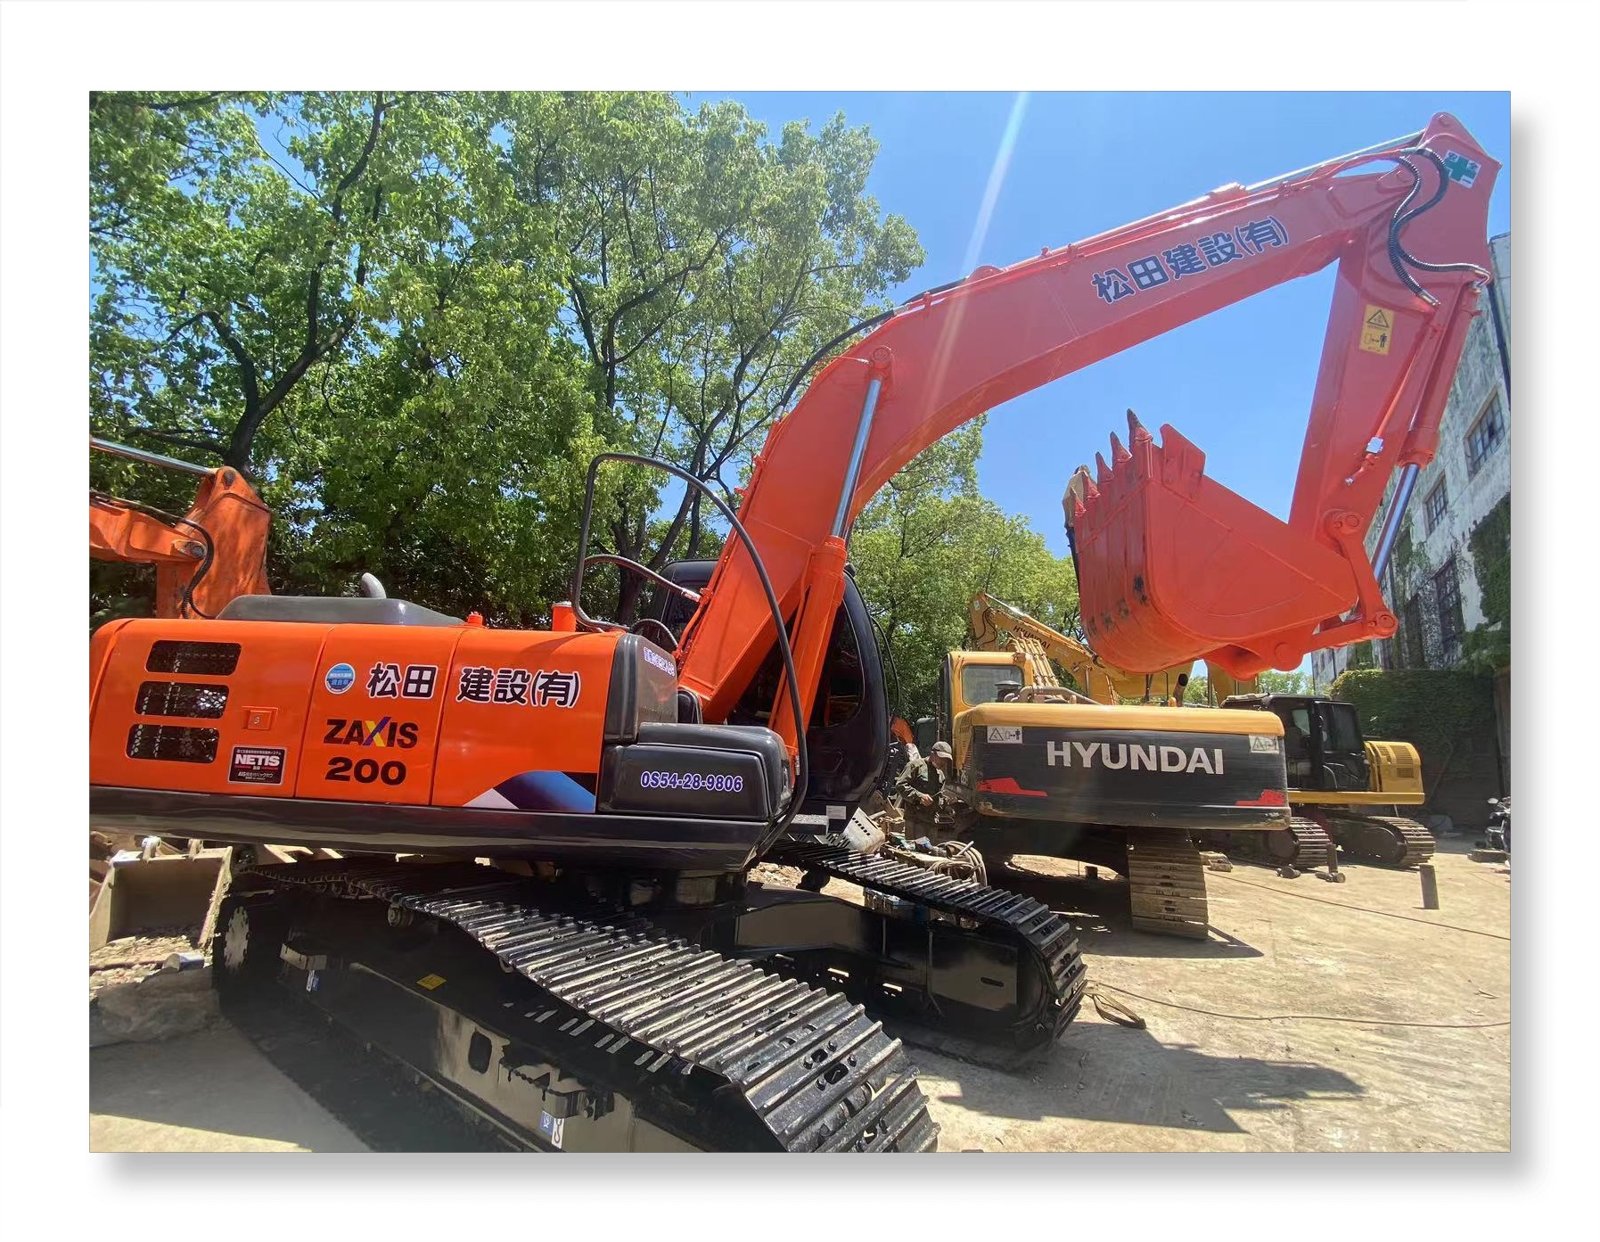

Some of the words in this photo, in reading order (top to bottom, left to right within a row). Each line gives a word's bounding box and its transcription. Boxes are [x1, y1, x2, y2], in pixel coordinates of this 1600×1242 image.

[1092, 216, 1289, 304] 松田建設(有)
[323, 716, 419, 749] ZAXIS
[234, 753, 280, 767] NETIS
[325, 756, 407, 785] 200
[1047, 741, 1225, 775] HYUNDAI
